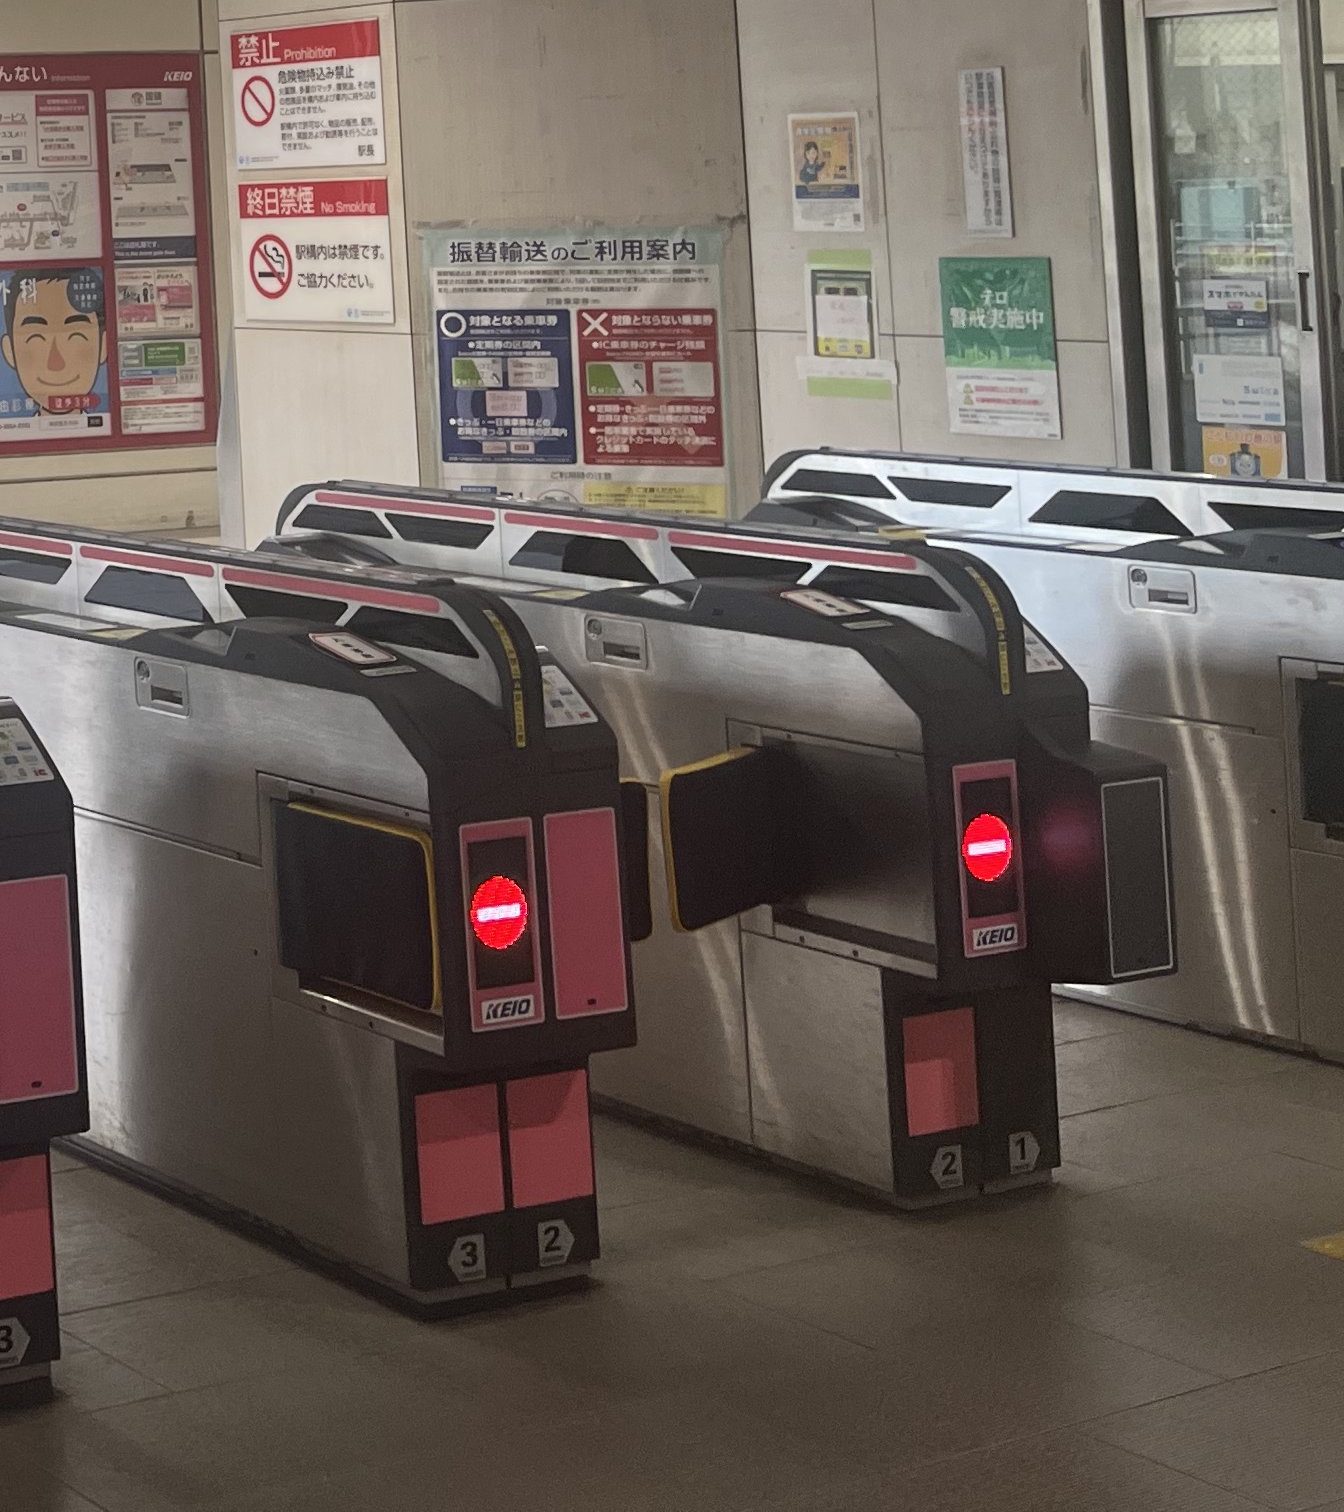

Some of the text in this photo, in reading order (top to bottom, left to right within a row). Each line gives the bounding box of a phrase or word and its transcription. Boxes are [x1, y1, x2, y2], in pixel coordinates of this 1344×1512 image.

[238, 34, 281, 66] 禁止
[284, 46, 336, 60] Prohibition
[163, 71, 193, 81] KEIO
[358, 144, 375, 156] 駅長
[247, 186, 315, 215] 終日禁煙
[321, 201, 375, 214] No Smoking
[296, 244, 384, 261] 駅構内は禁煙です。
[449, 239, 696, 264] 振替輸送のご利用案内
[297, 272, 375, 289] ご協力ください。
[950, 307, 1044, 330] 警戒実施中
[976, 927, 1015, 946] KEIO
[486, 998, 531, 1021] KEIO
[1018, 1137, 1027, 1161] 1
[941, 1152, 957, 1176] 2
[543, 1226, 561, 1253] 2
[460, 1241, 478, 1267] 3
